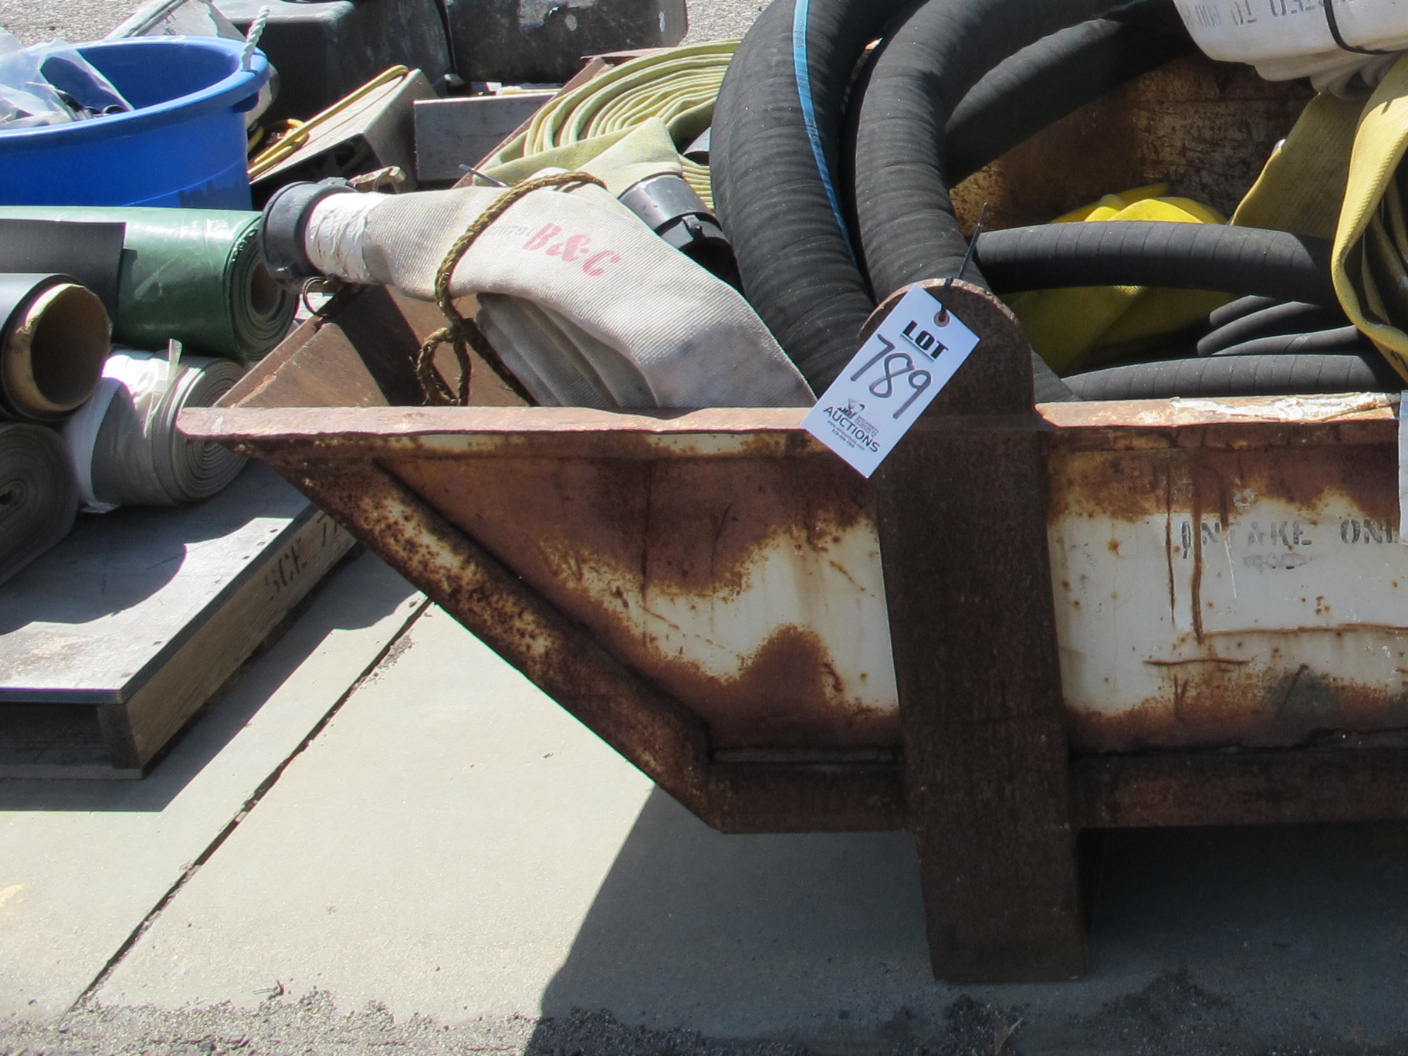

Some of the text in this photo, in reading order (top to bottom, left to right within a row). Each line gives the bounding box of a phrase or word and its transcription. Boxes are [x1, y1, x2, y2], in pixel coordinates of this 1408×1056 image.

[522, 223, 622, 277] B&C
[902, 320, 949, 360] LOT
[850, 333, 932, 420] 789
[824, 406, 881, 453] AUCTIONS
